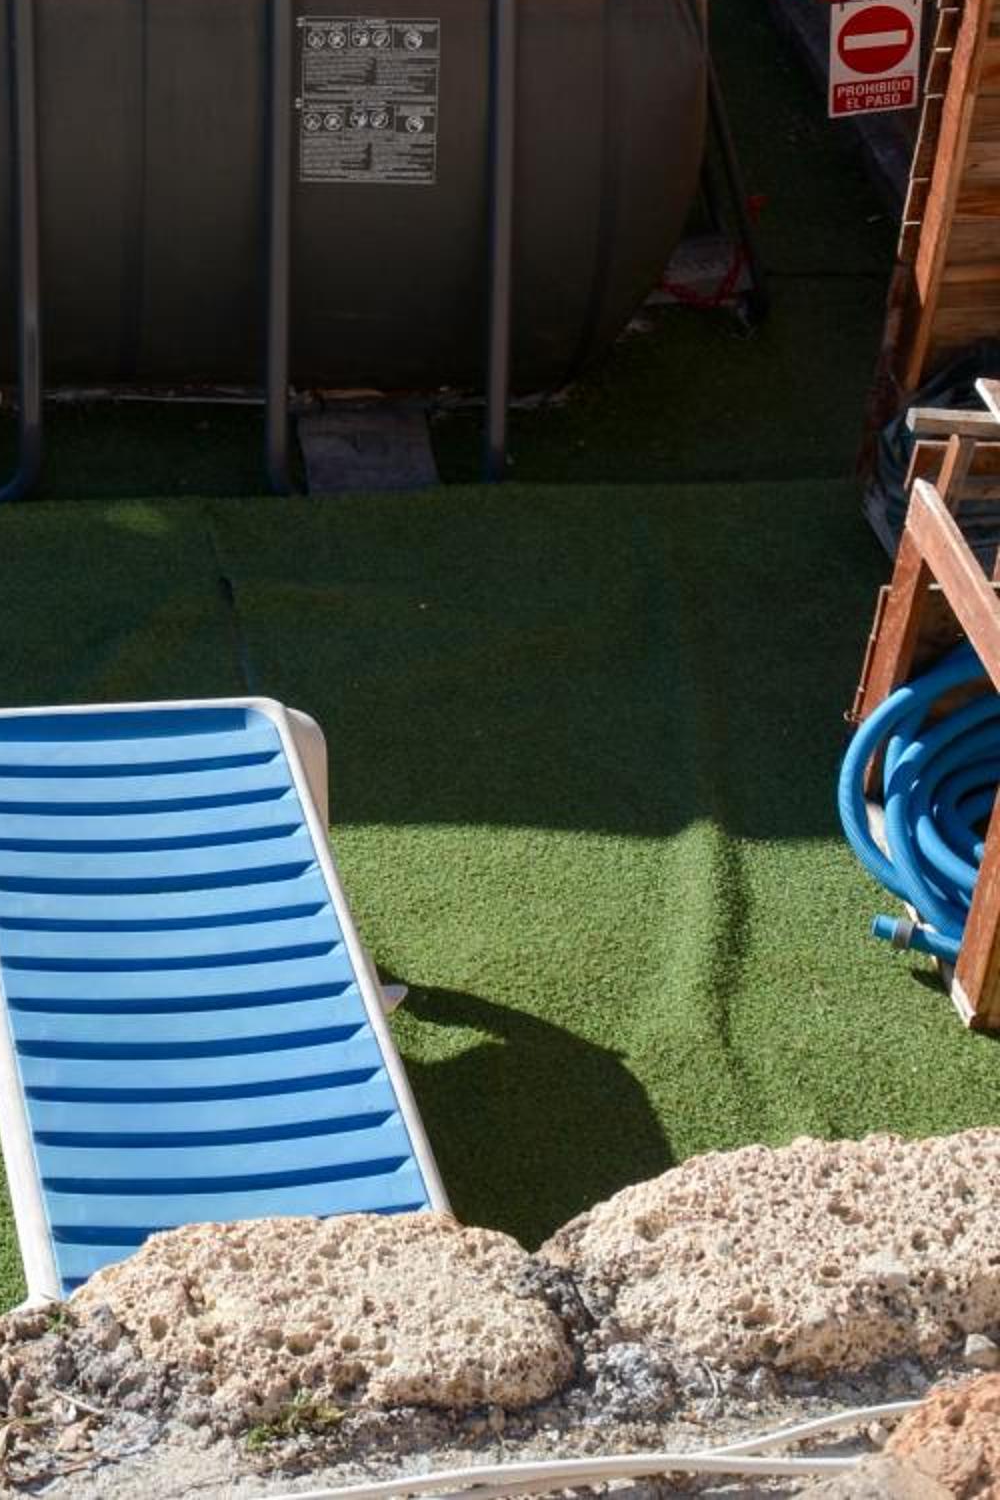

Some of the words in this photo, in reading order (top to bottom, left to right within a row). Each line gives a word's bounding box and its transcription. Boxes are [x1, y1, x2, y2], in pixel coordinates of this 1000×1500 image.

[837, 79, 911, 98] PROHIBIDO
[846, 98, 861, 109] EL
[865, 94, 901, 107] PASO
